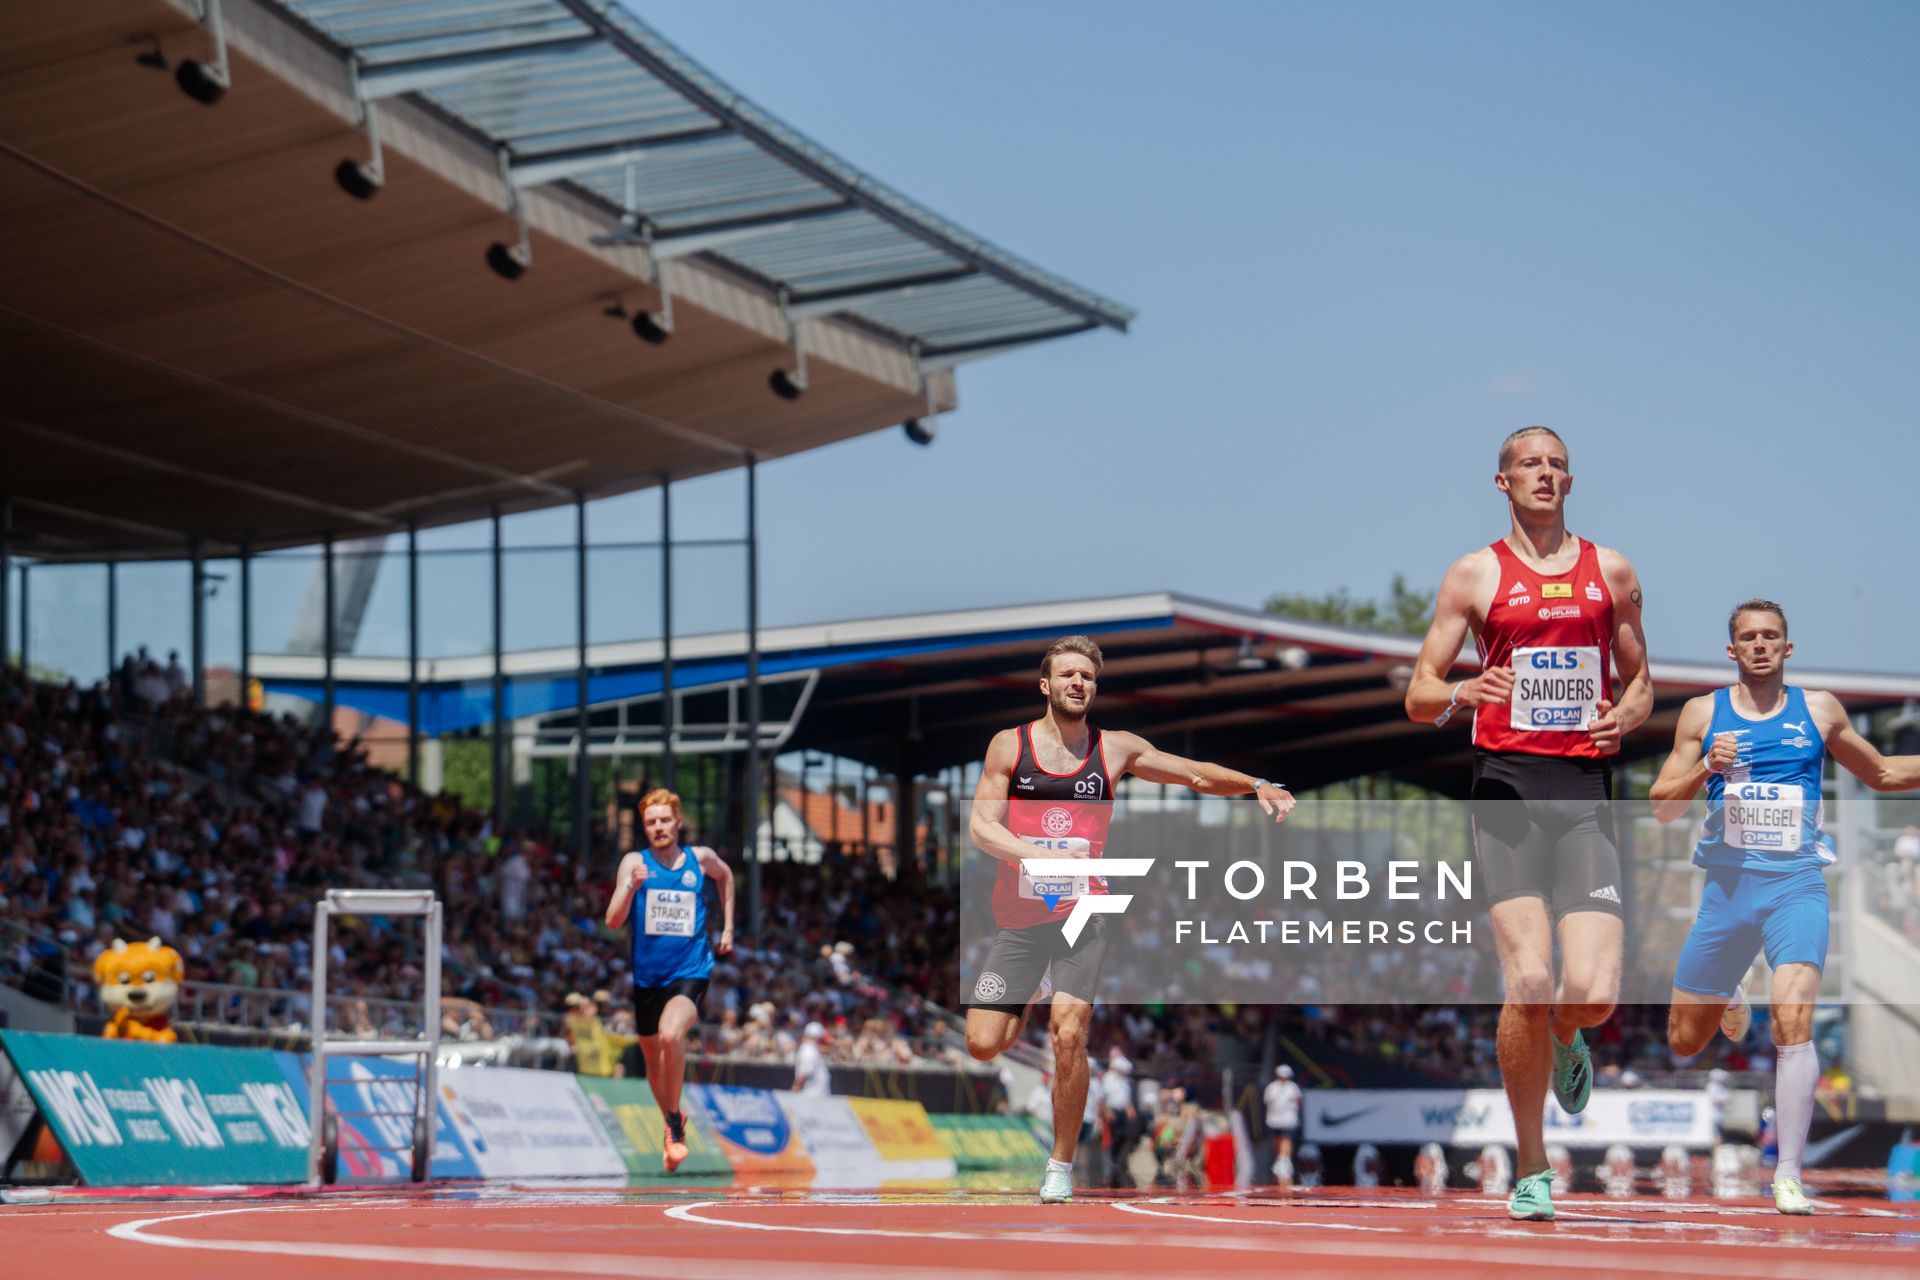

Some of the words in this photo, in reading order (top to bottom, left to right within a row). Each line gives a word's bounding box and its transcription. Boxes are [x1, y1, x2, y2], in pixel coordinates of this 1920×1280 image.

[1520, 678, 1594, 701] SANDERS
[1553, 709, 1580, 719] PLAN
[1074, 780, 1096, 794] OS
[1728, 806, 1797, 828] SCHLEGEL
[1757, 833, 1781, 841] PLAN
[1049, 883, 1072, 893] PLAN
[650, 905, 691, 920] STRAUCH
